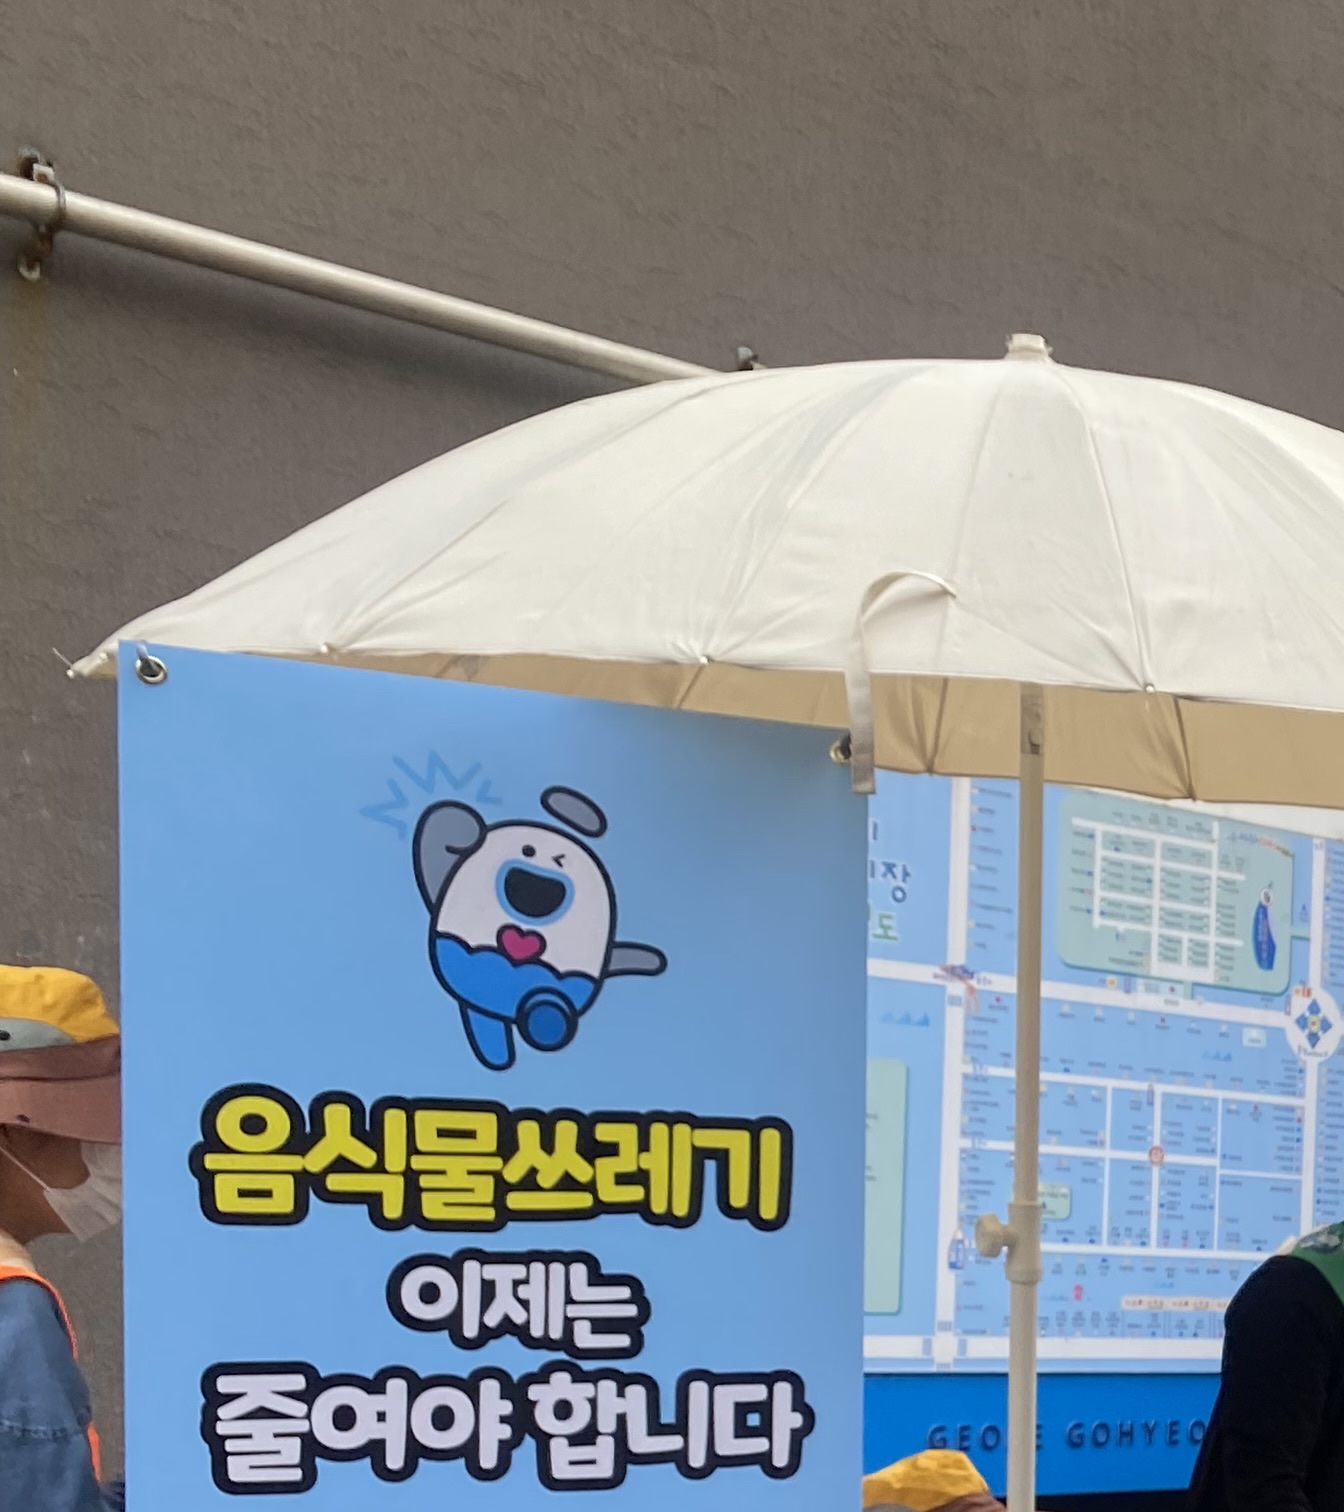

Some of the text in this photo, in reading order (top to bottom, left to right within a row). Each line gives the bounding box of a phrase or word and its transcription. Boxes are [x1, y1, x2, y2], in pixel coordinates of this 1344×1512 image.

[196, 1088, 789, 1226] 음식물쓰레기
[391, 1253, 647, 1355] 이제는
[207, 1366, 808, 1490] 줄여야 합니다
[926, 1419, 1207, 1452] GEOE GOHYEO
